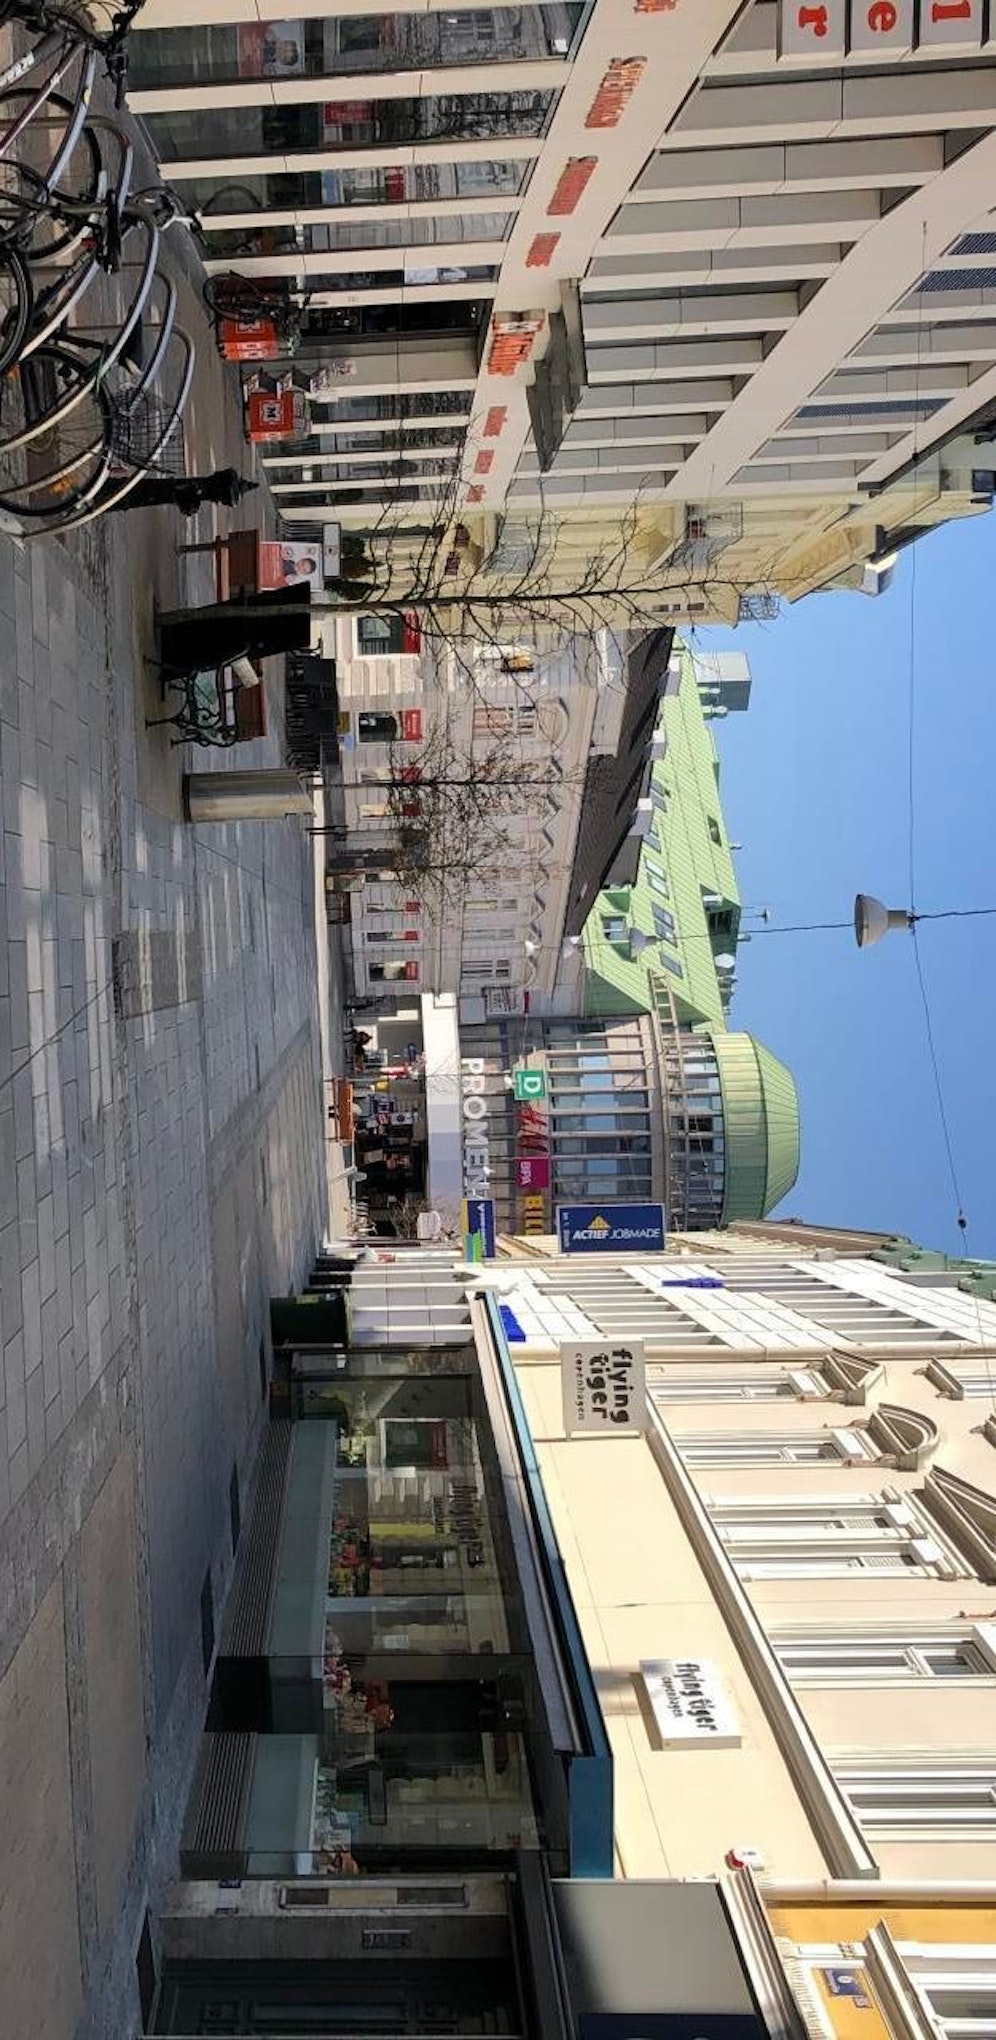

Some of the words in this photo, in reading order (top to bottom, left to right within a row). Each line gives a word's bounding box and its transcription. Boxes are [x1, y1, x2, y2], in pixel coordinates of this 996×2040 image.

[572, 1229, 609, 1240] ACTIEF
[609, 1228, 661, 1240] JOBMADE
[575, 1352, 585, 1420] copenhagen
[586, 1353, 609, 1419] tiger
[607, 1348, 635, 1424] flying
[673, 1662, 706, 1697] flying
[686, 1698, 718, 1731] tiger
